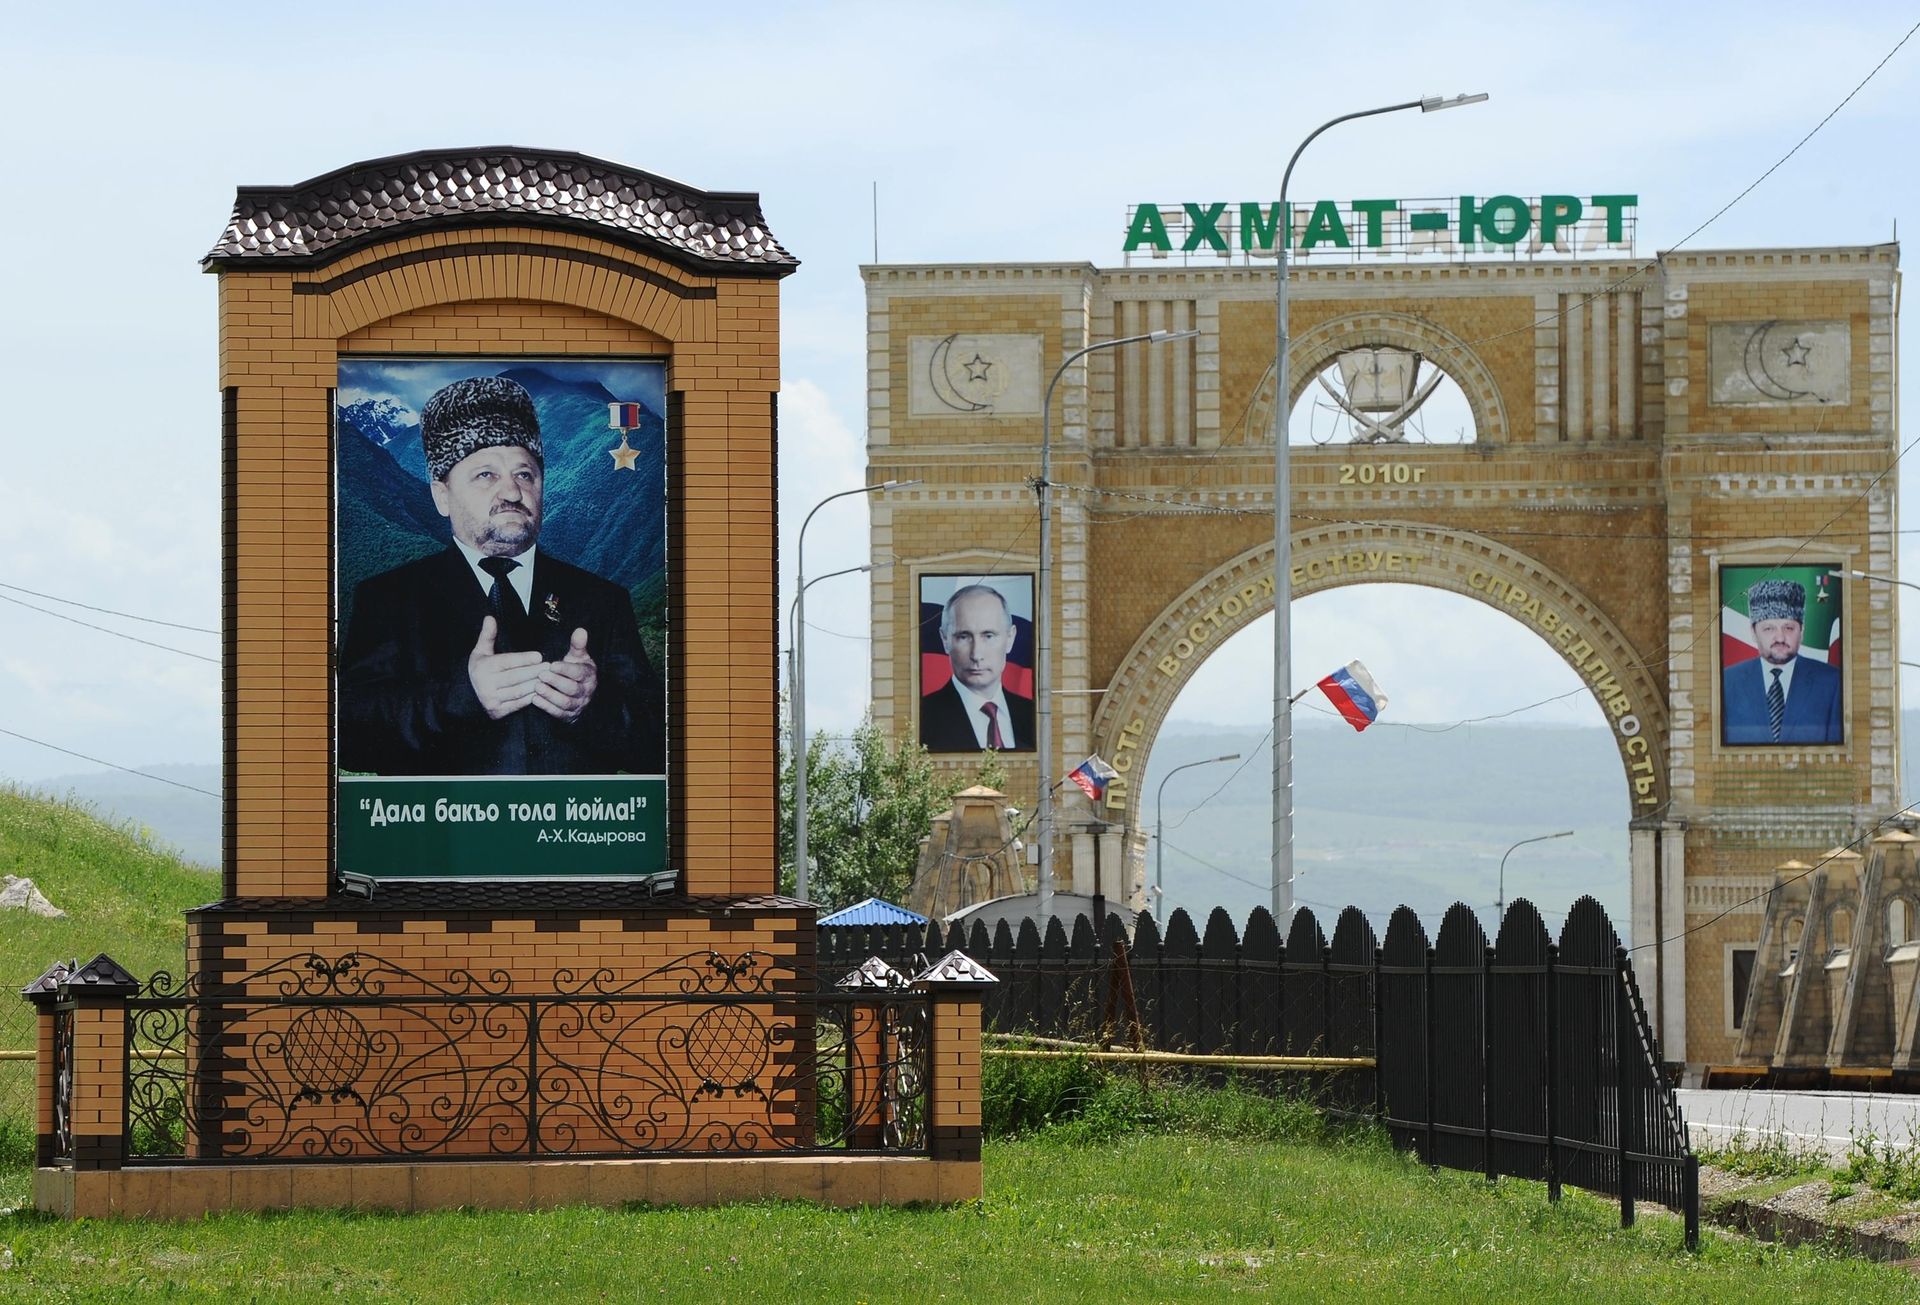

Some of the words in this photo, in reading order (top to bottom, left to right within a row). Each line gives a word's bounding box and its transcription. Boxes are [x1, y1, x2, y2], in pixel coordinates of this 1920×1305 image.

[1123, 195, 1638, 251] АХМАТ-ЮРТ
[1340, 463, 1426, 484] 2010г
[1105, 718, 1146, 810] ПУСТЬ
[1468, 569, 1658, 805] СПРАВЕДЛИВОСТЬ!
[434, 798, 500, 822] бакъо
[508, 802, 556, 822] тола
[536, 829, 646, 846] А-Х.Кадырова
